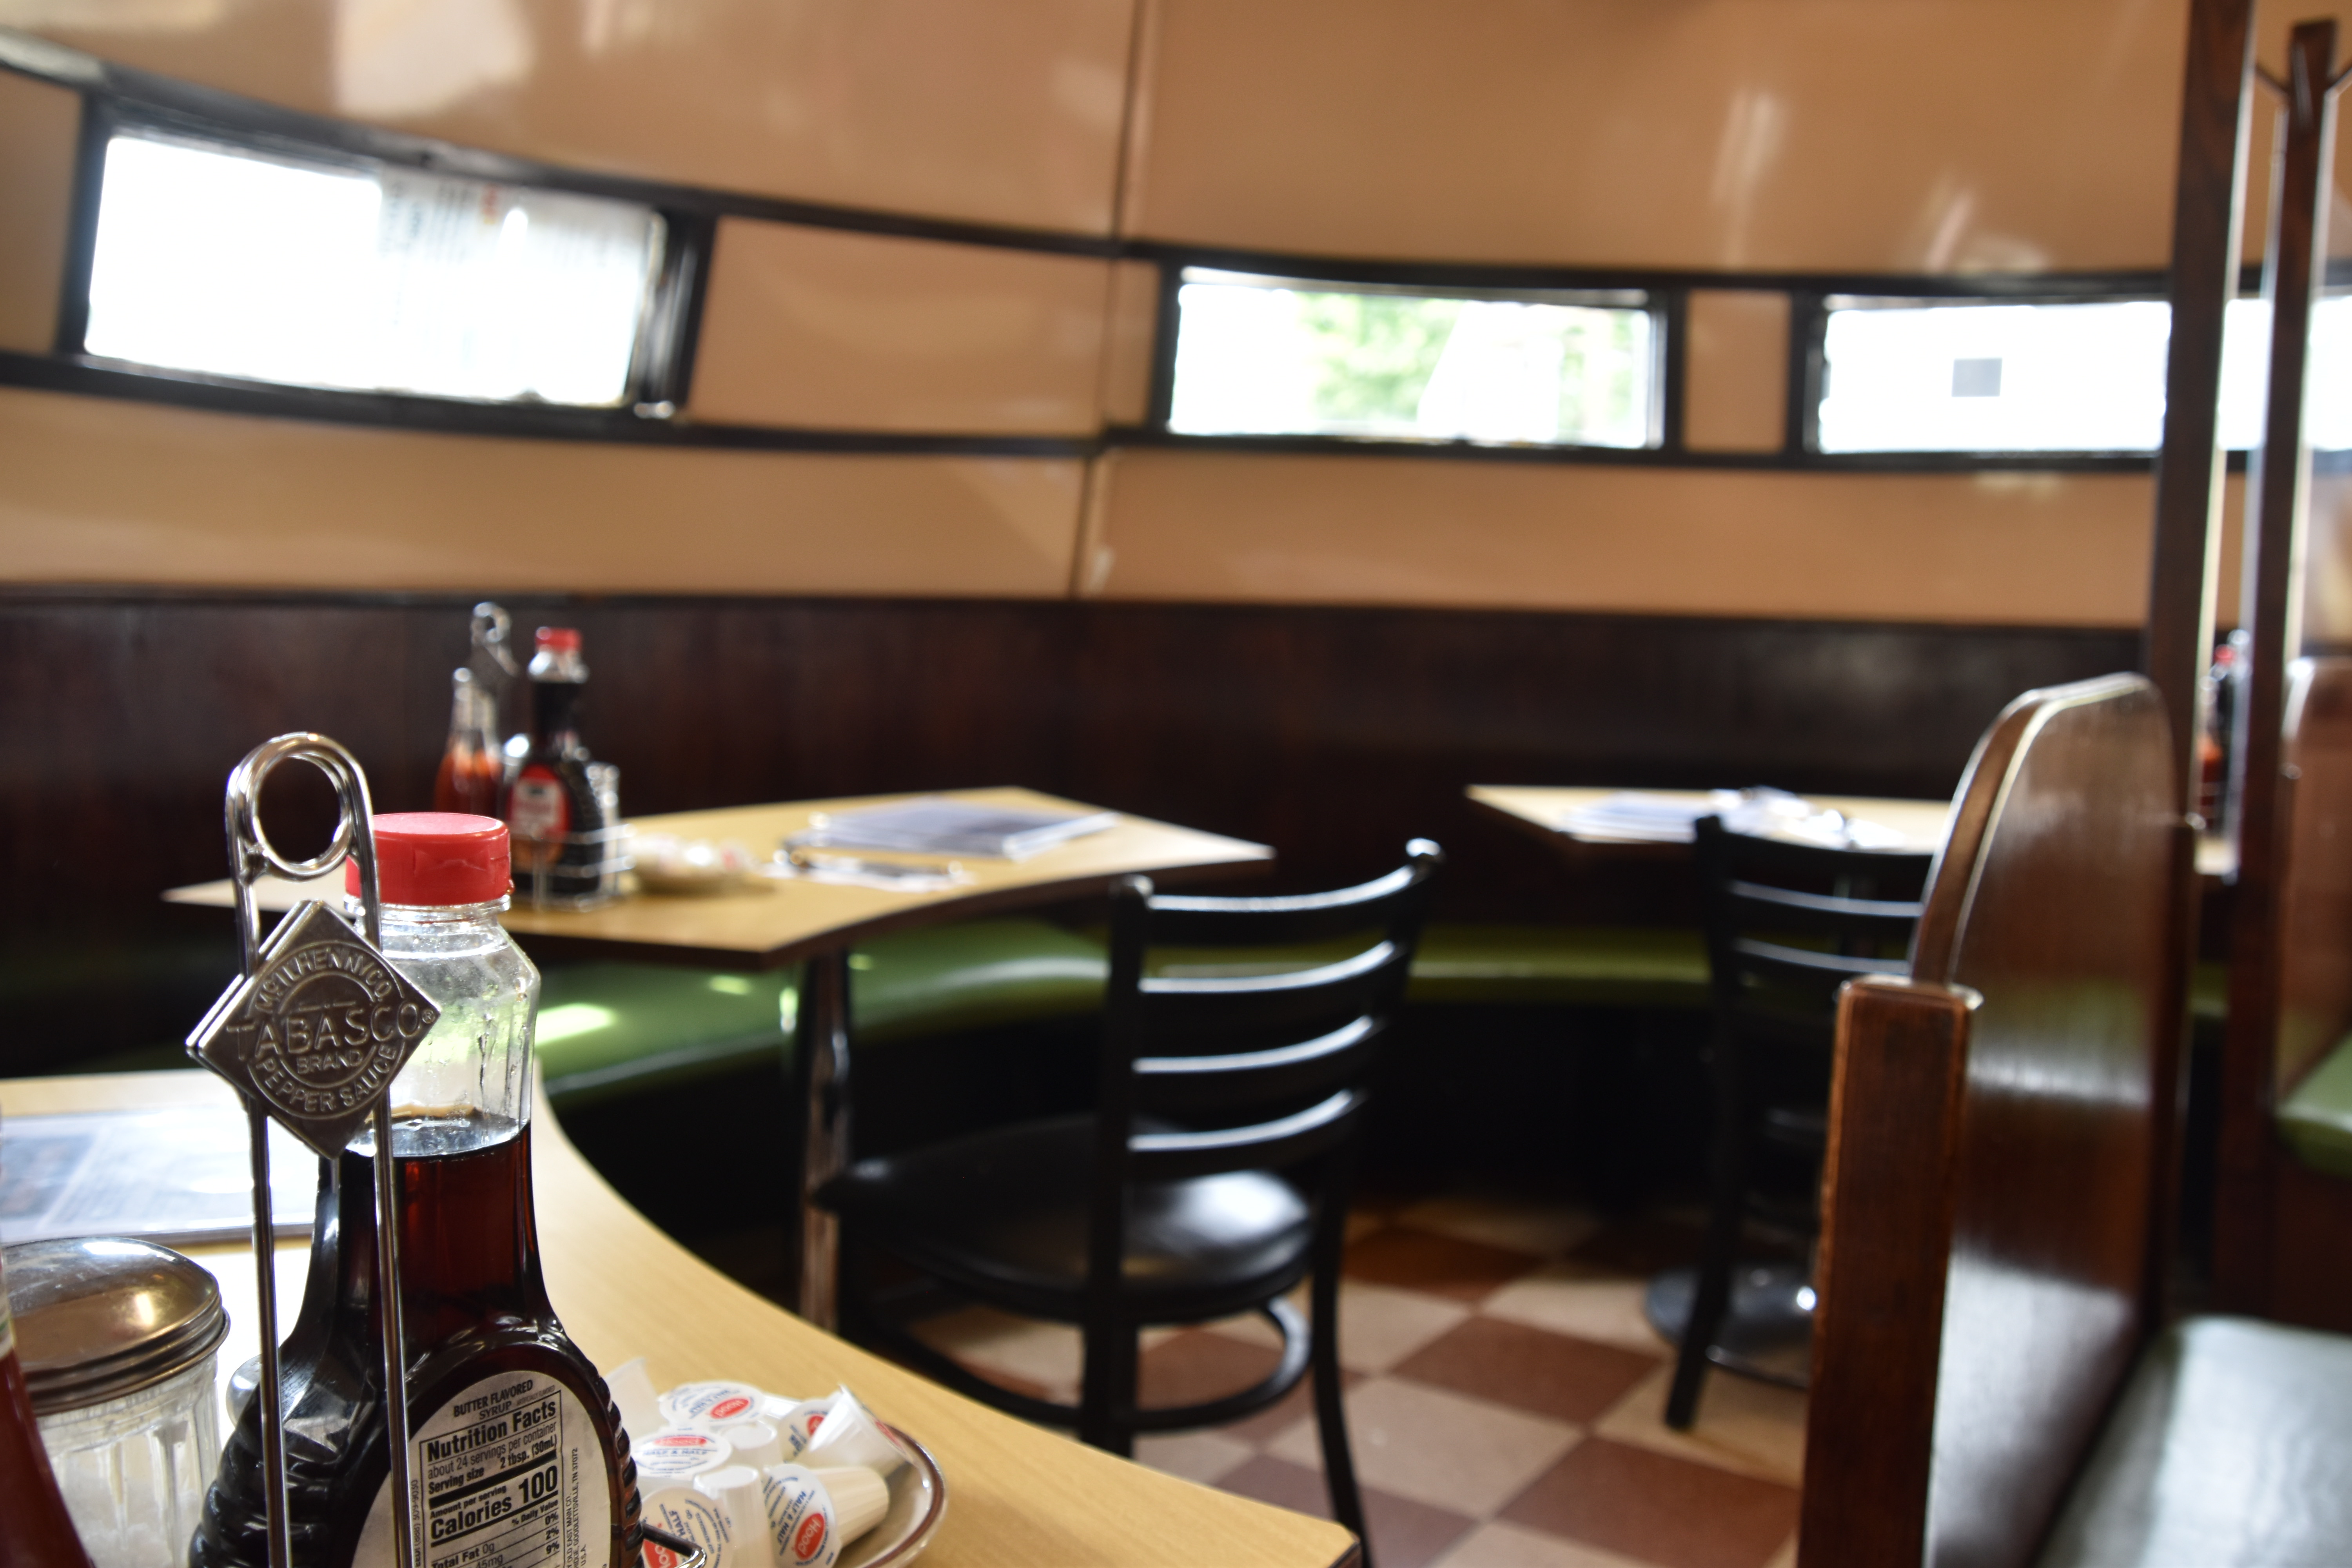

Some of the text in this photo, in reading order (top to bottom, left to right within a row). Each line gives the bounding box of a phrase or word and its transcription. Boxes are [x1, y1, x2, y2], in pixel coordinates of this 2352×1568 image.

[256, 1044, 396, 1112] PEPPER SAUCE
[296, 1049, 361, 1074] BRAND
[454, 1379, 533, 1417] BUTTER FLAVORED
[479, 1401, 512, 1420] SYRUP
[427, 1401, 556, 1462] Nutrition Facts
[428, 1421, 557, 1479] about 24 servings per container
[428, 1434, 557, 1494] Serving size 2 tbsp. (30mL)
[572, 1472, 578, 1483] TN
[430, 1485, 506, 1519] Amount per serving
[432, 1465, 557, 1539] Calories 100
[521, 1510, 538, 1523] Daily
[540, 1499, 558, 1513] Value
[432, 1555, 459, 1568] Total
[462, 1548, 479, 1562] Fat
[483, 1543, 494, 1555] 0g
[545, 1512, 559, 1525] 0%
[546, 1526, 559, 1540] 2%
[669, 1510, 686, 1537] HALF
[798, 1516, 822, 1556] Hood
